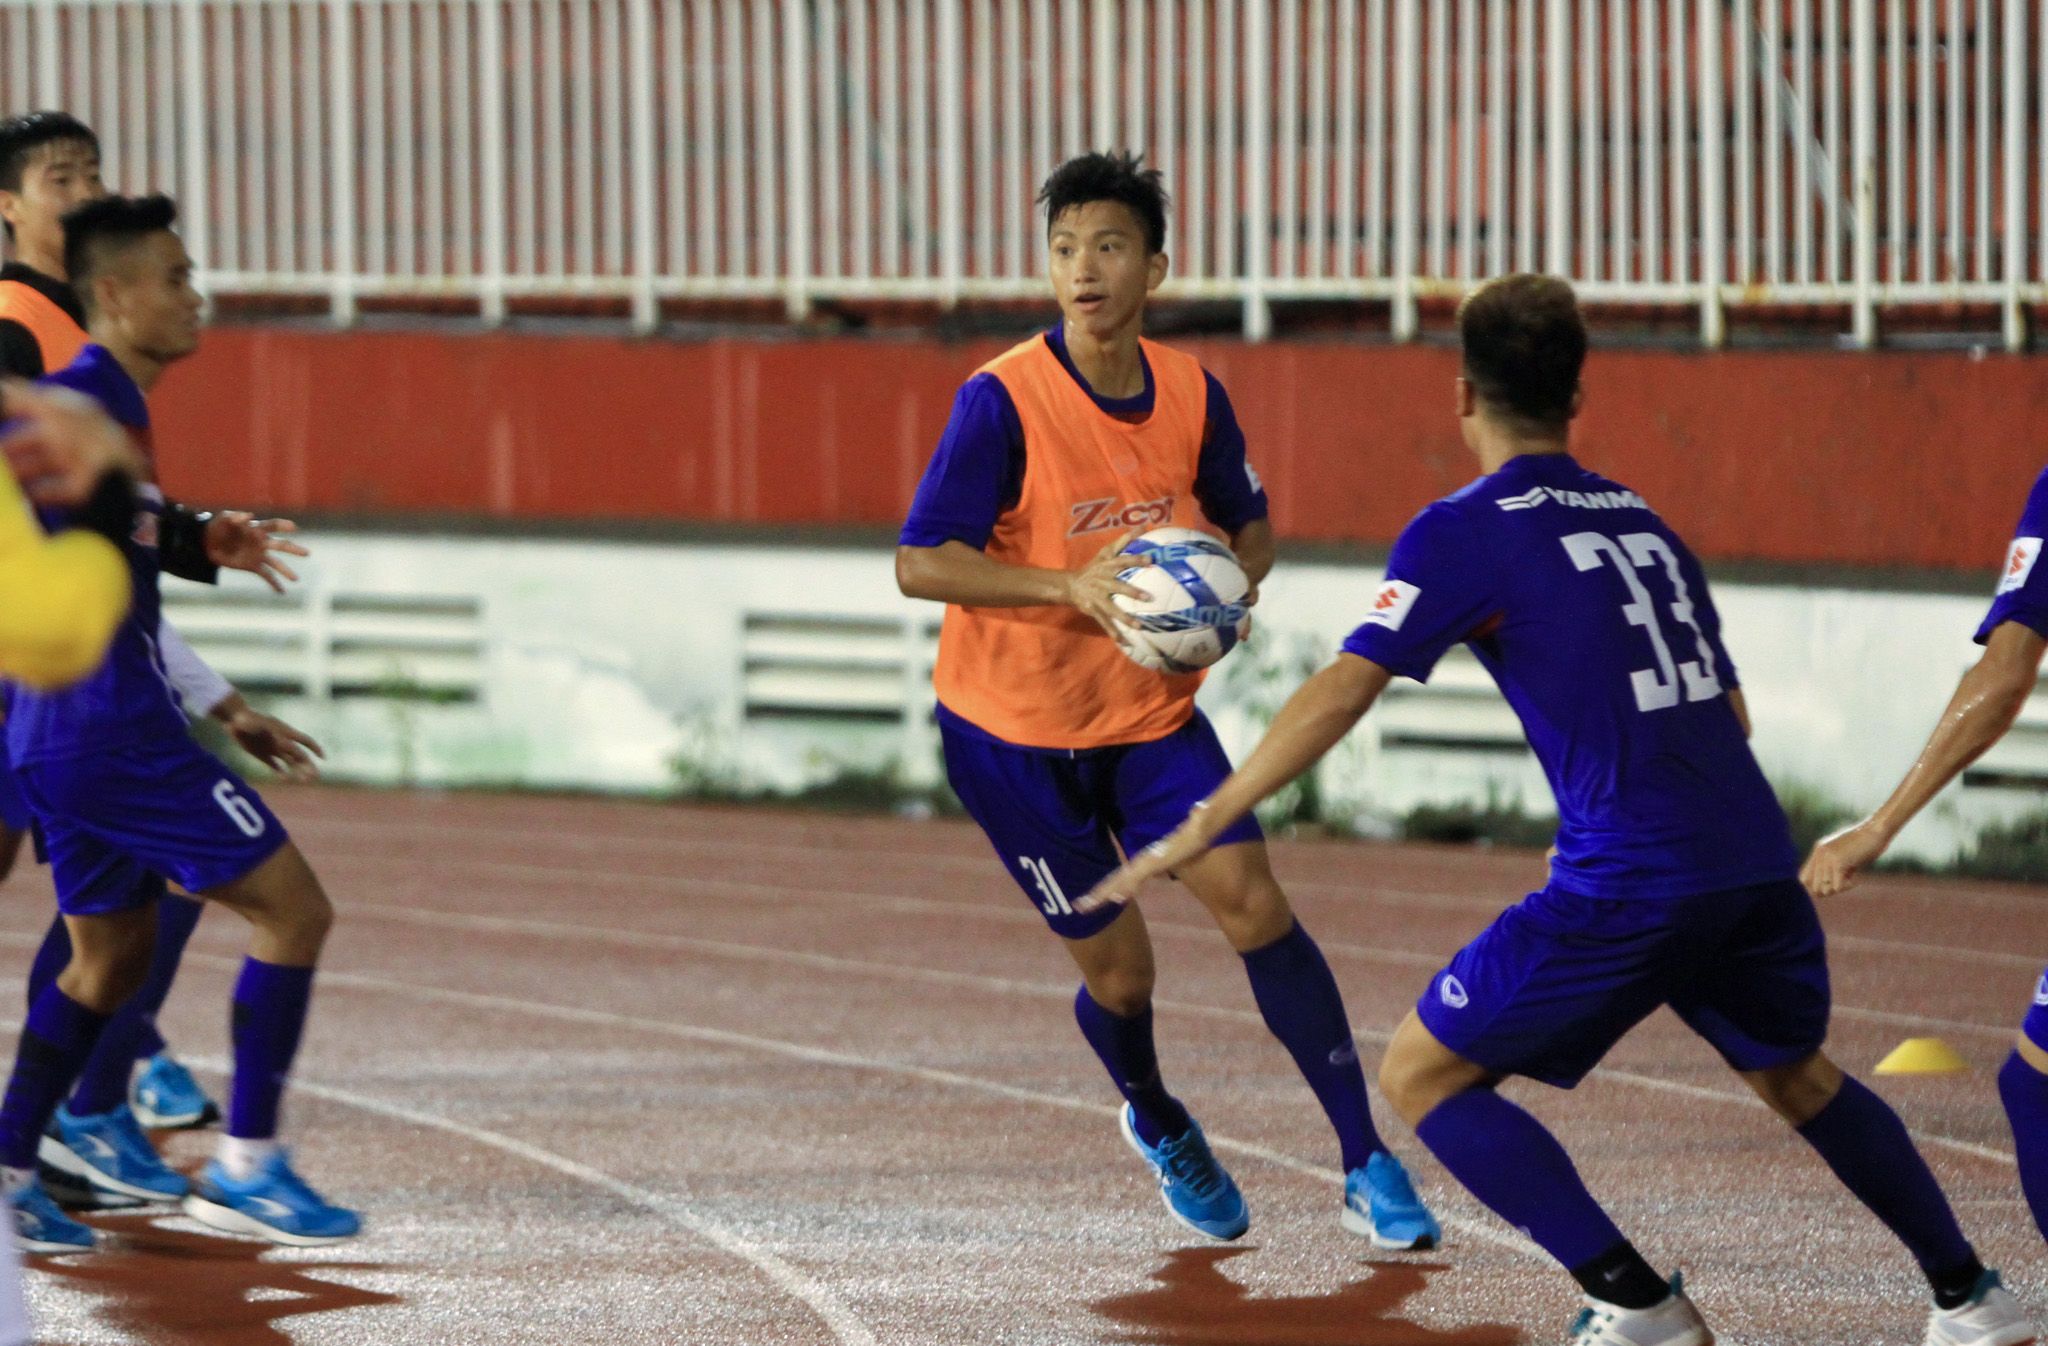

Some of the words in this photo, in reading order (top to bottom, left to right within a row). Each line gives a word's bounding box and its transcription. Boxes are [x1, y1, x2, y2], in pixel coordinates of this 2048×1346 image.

[1560, 531, 1724, 712] 33
[212, 778, 265, 837] 6
[1019, 856, 1073, 915] 31
